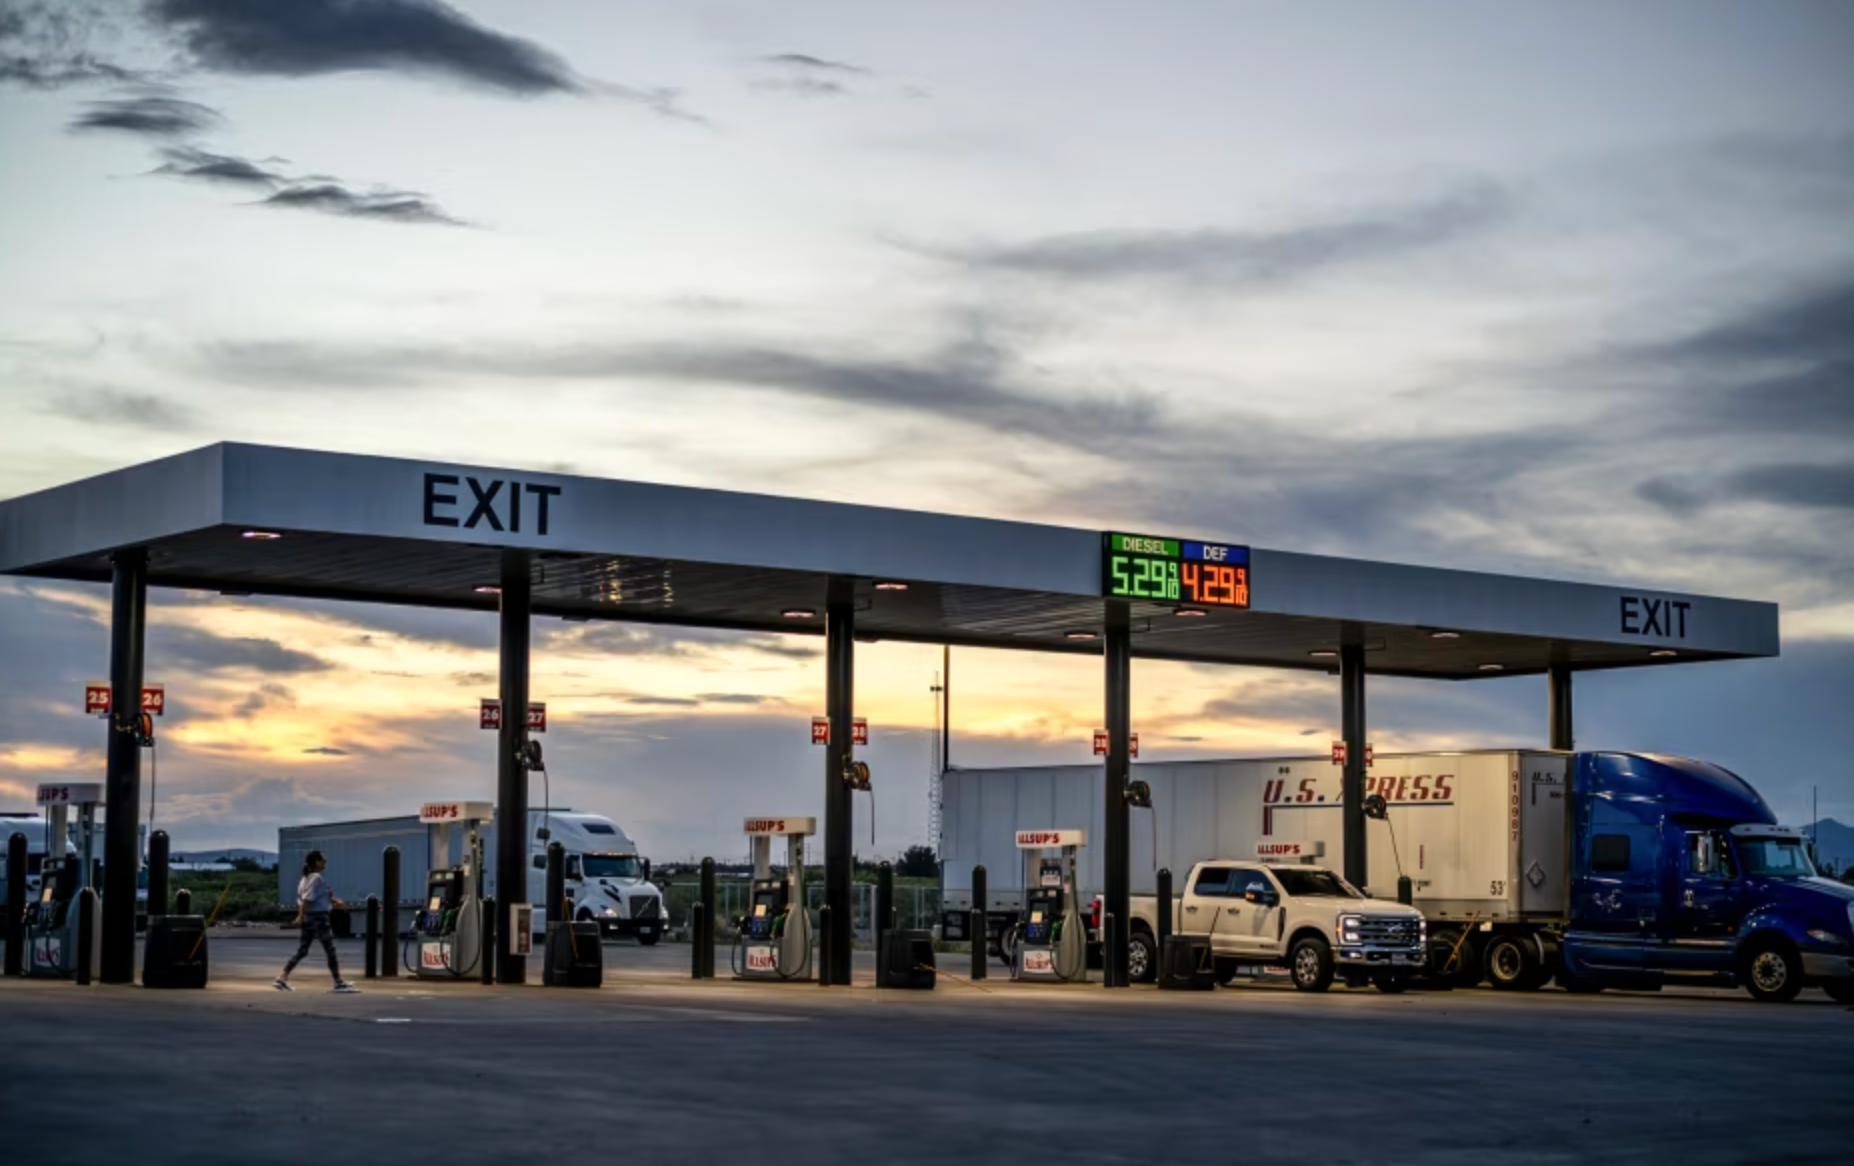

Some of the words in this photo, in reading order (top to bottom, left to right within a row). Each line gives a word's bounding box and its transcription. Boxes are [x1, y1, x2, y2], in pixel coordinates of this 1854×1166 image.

[424, 473, 561, 535] EXIT
[1122, 537, 1168, 555] DIESEL
[1203, 545, 1228, 560] DEF
[1621, 596, 1691, 638] EXIT
[87, 690, 109, 704] 25
[142, 692, 162, 706] 26
[483, 708, 499, 720] 26
[528, 711, 544, 723] 27
[1263, 778, 1325, 803] U.S.
